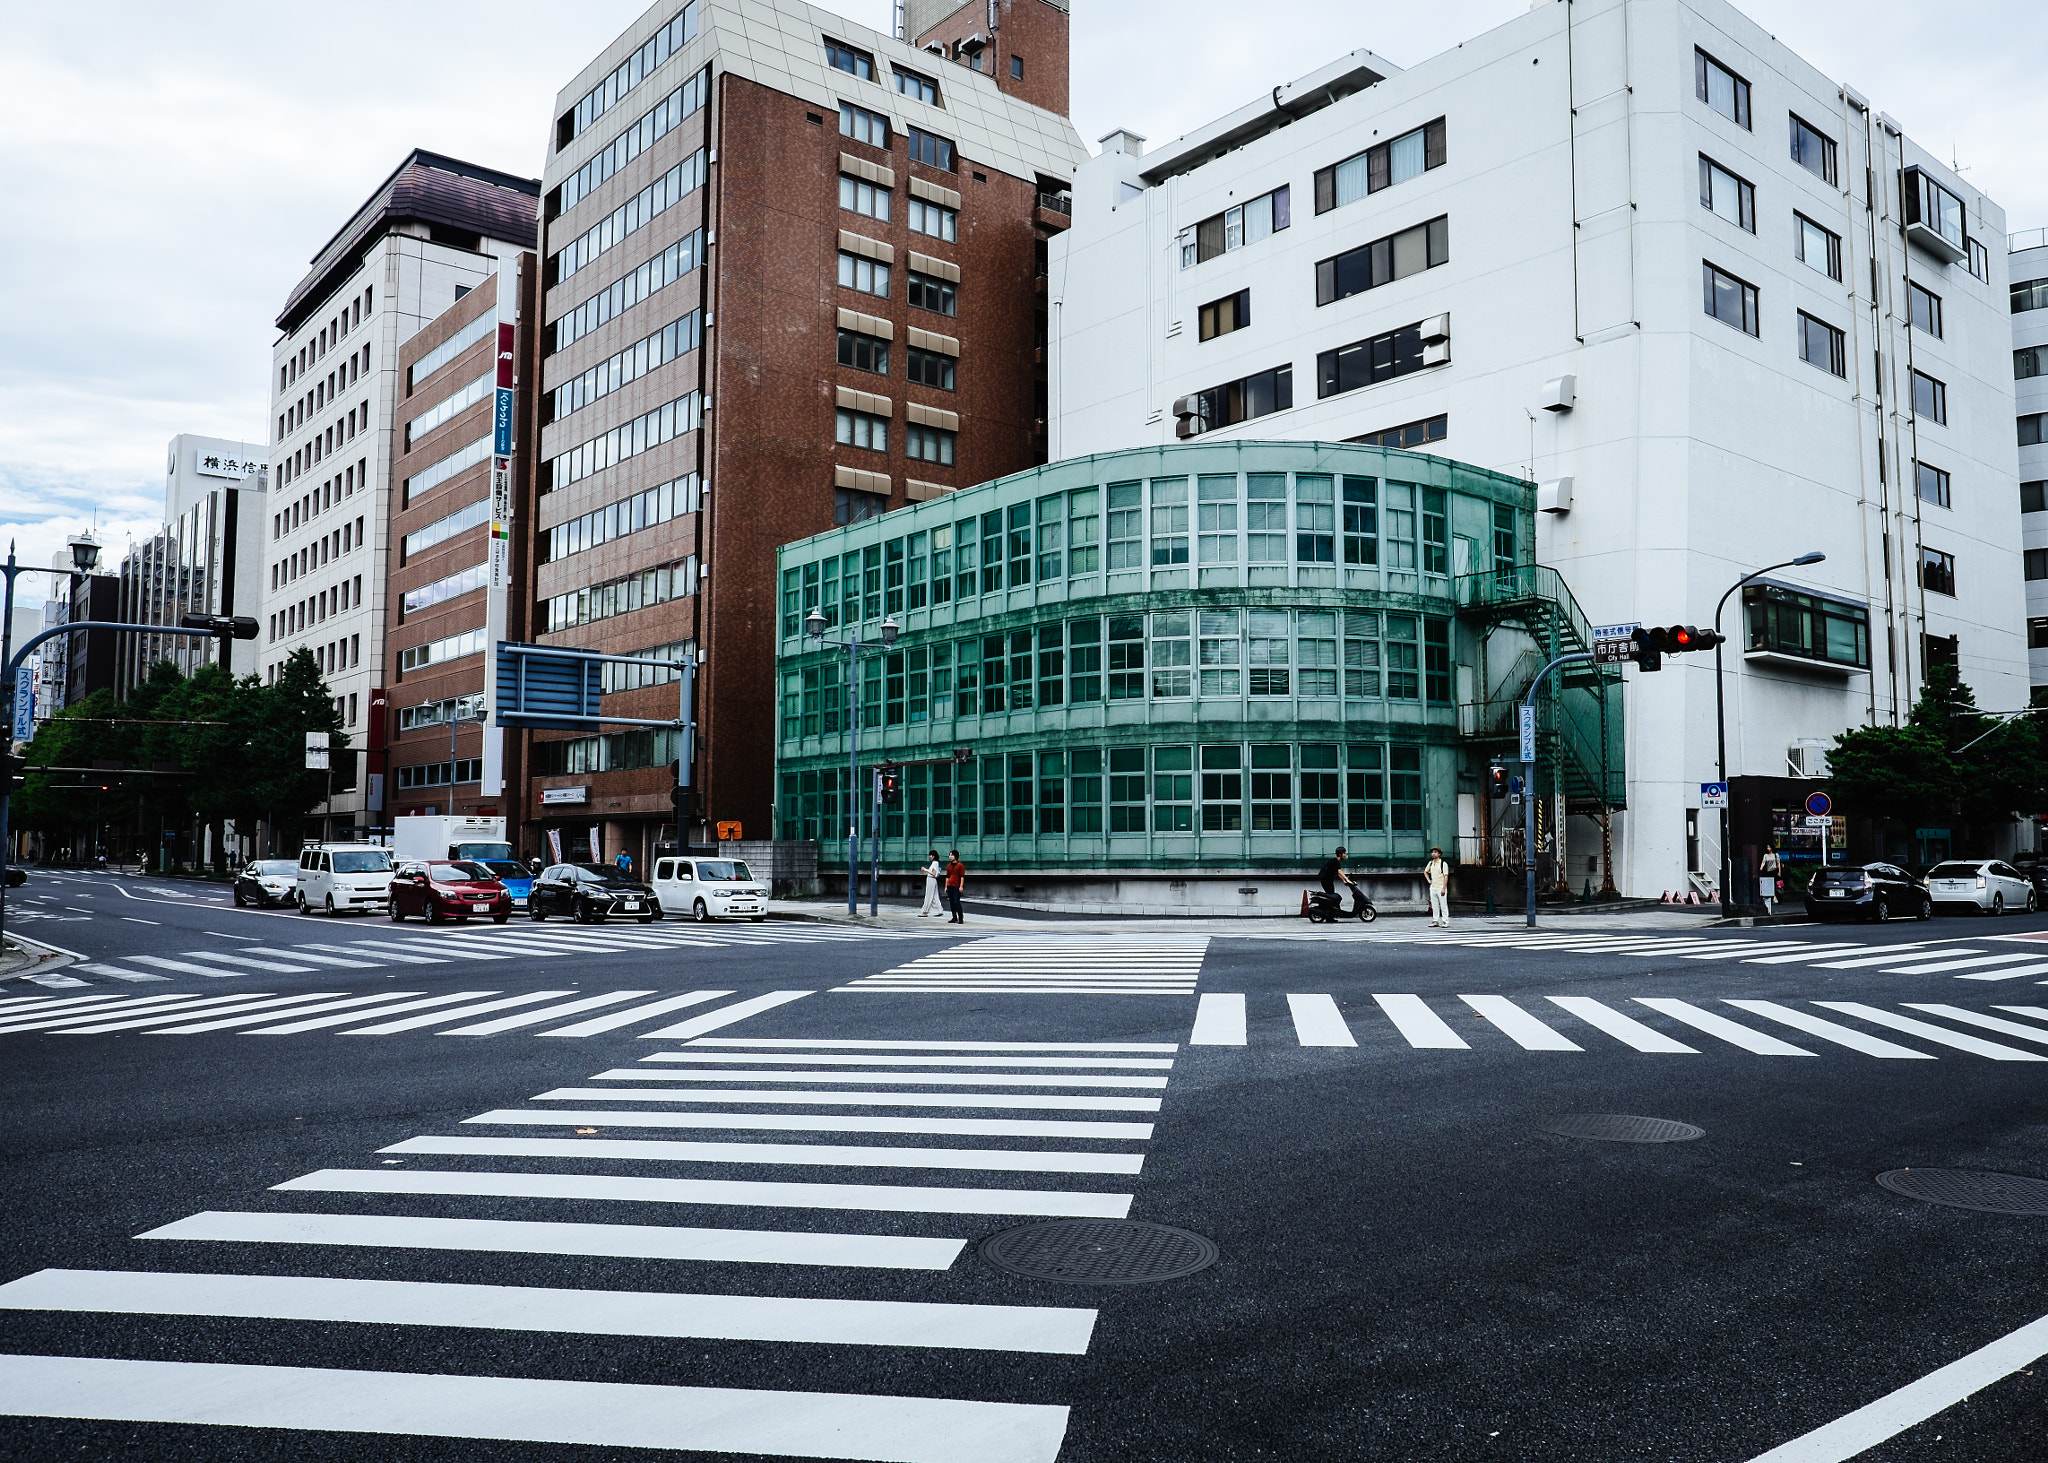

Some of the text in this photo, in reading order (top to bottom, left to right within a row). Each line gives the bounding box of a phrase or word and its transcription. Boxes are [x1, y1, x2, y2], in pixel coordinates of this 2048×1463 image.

[498, 351, 513, 360] JTB
[499, 392, 509, 428] Kubota
[1597, 641, 1640, 655] 市庁舎前
[1607, 653, 1630, 662] City Hall
[17, 671, 30, 736] スクランブル式
[372, 698, 386, 706] JTB
[1523, 709, 1532, 759] スクランブル式
